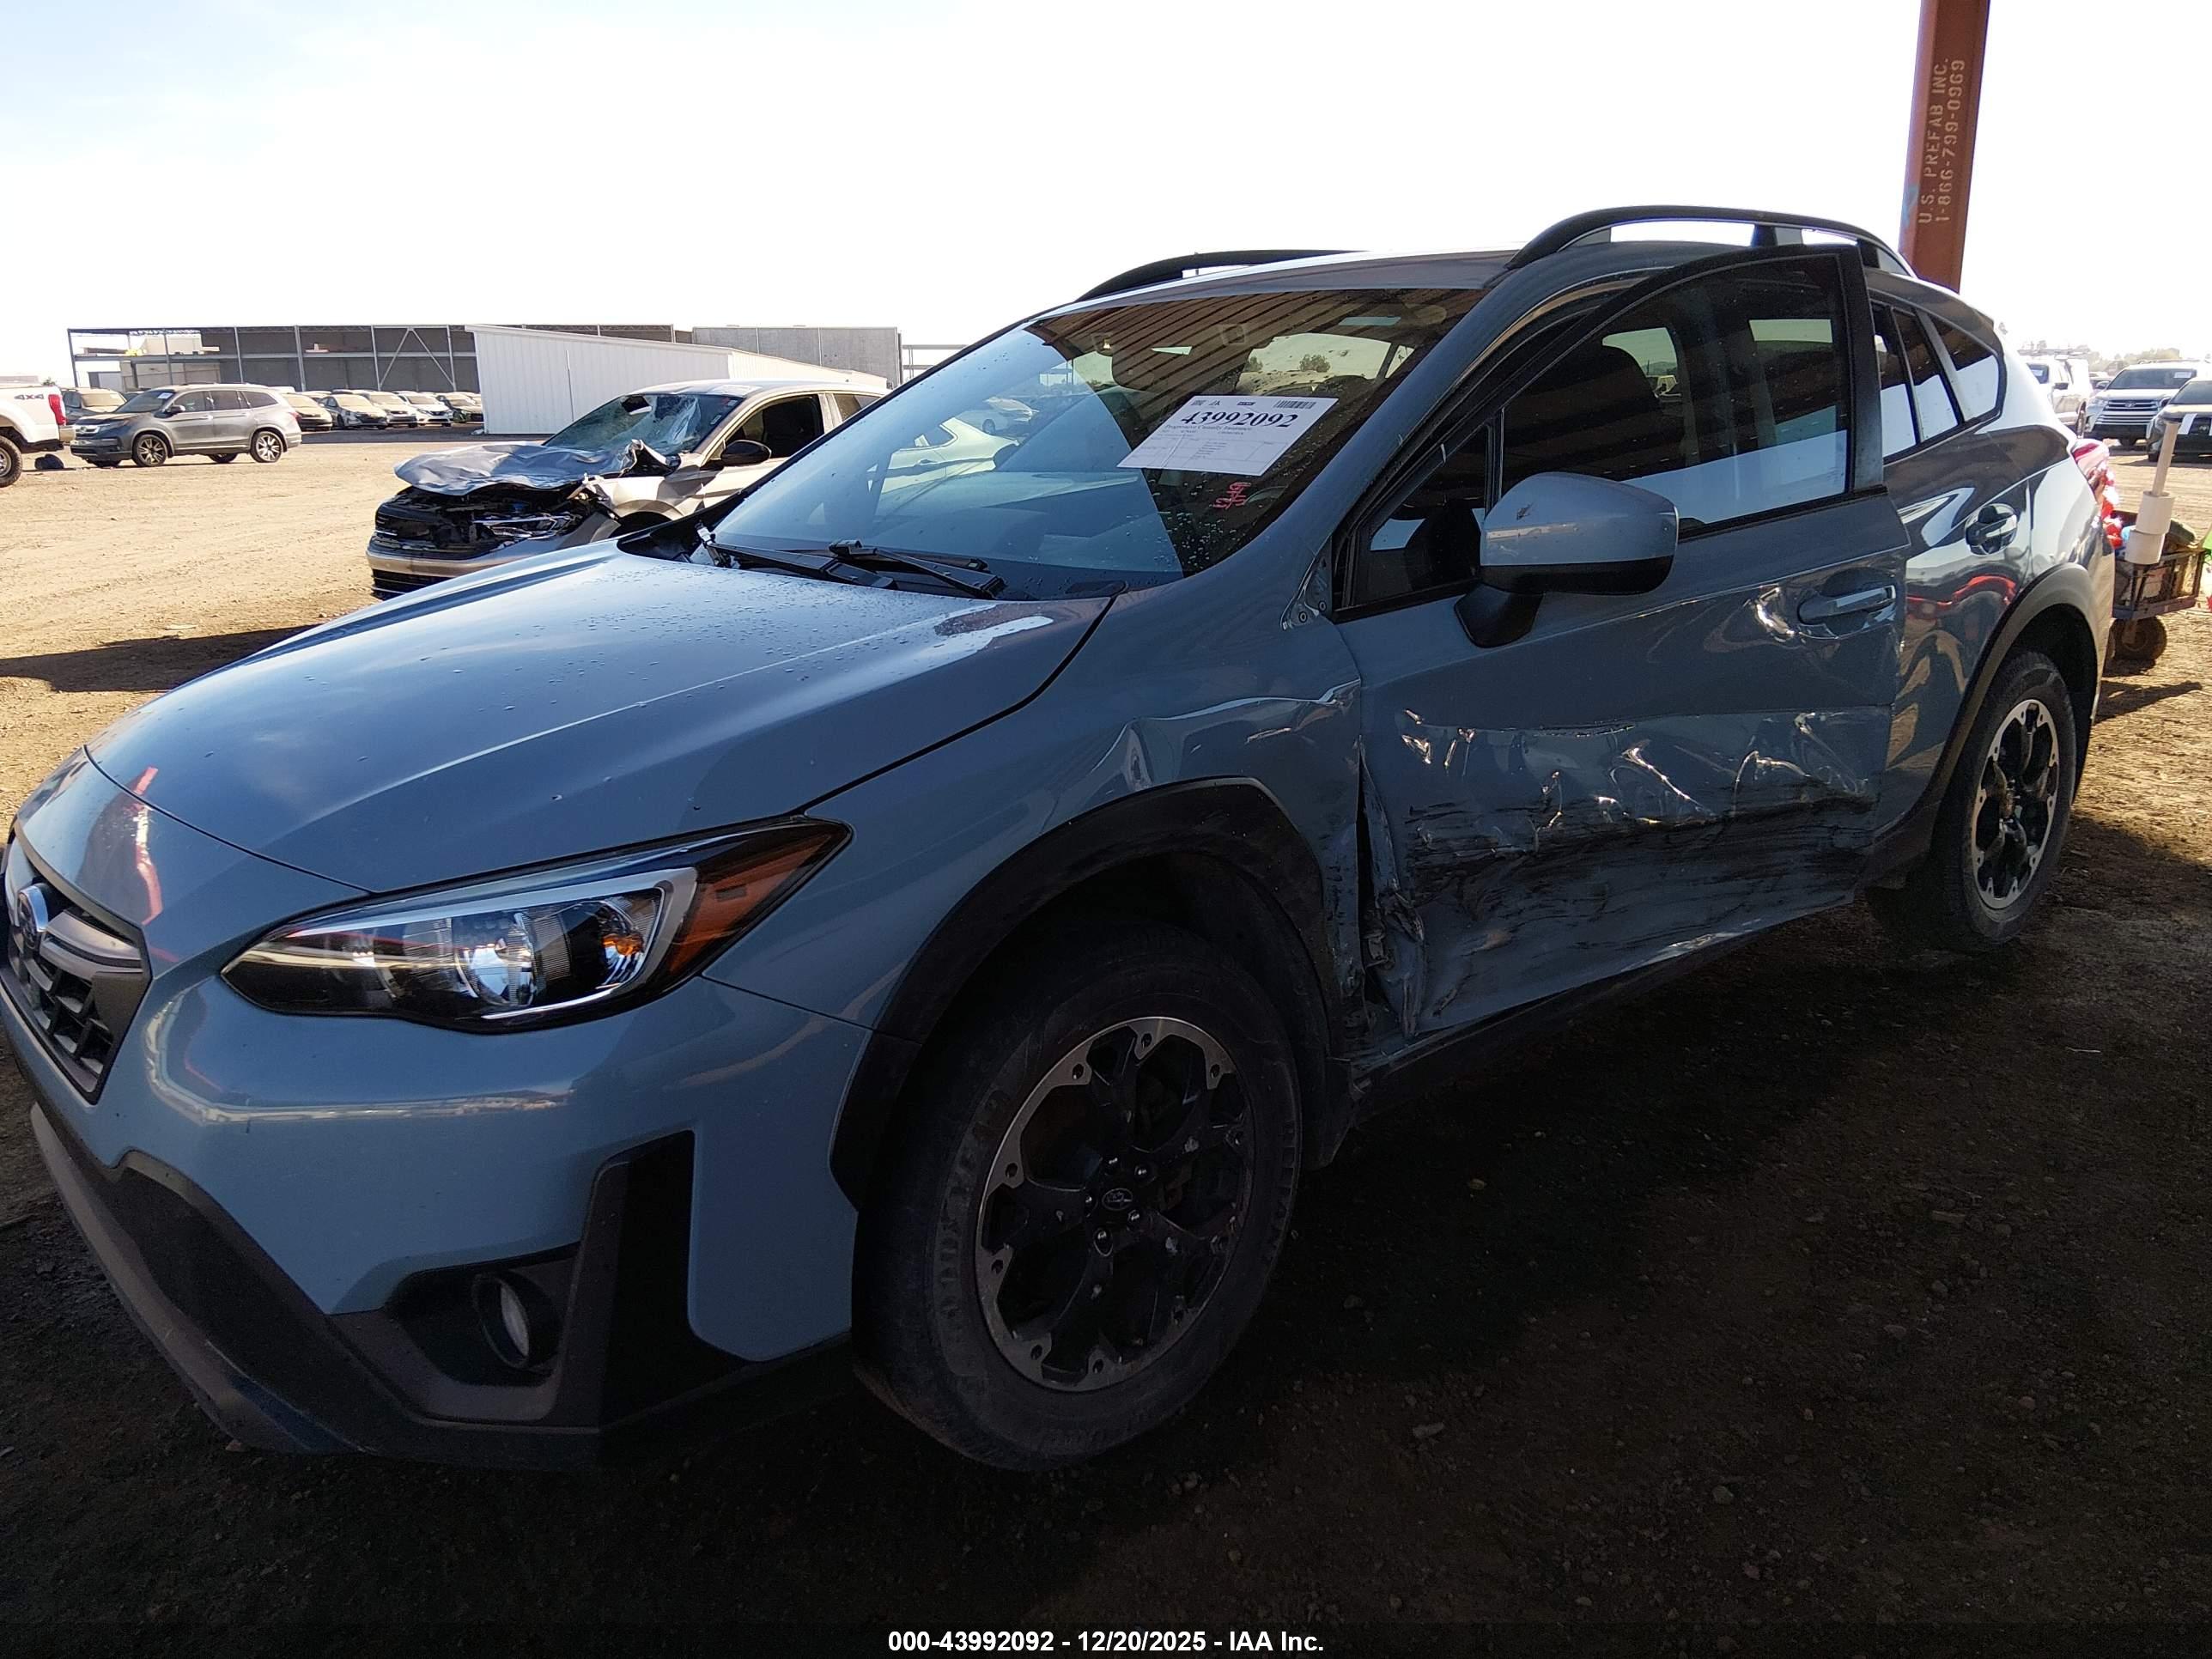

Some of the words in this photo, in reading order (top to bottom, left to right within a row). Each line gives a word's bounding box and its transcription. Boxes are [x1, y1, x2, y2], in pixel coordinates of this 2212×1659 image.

[1931, 58, 1949, 94] INC.
[1923, 105, 1944, 177] PREFAB
[1935, 59, 1966, 222] 1-866-799-0969
[1918, 188, 1936, 223] U.S.
[1181, 410, 1298, 428] 43992092
